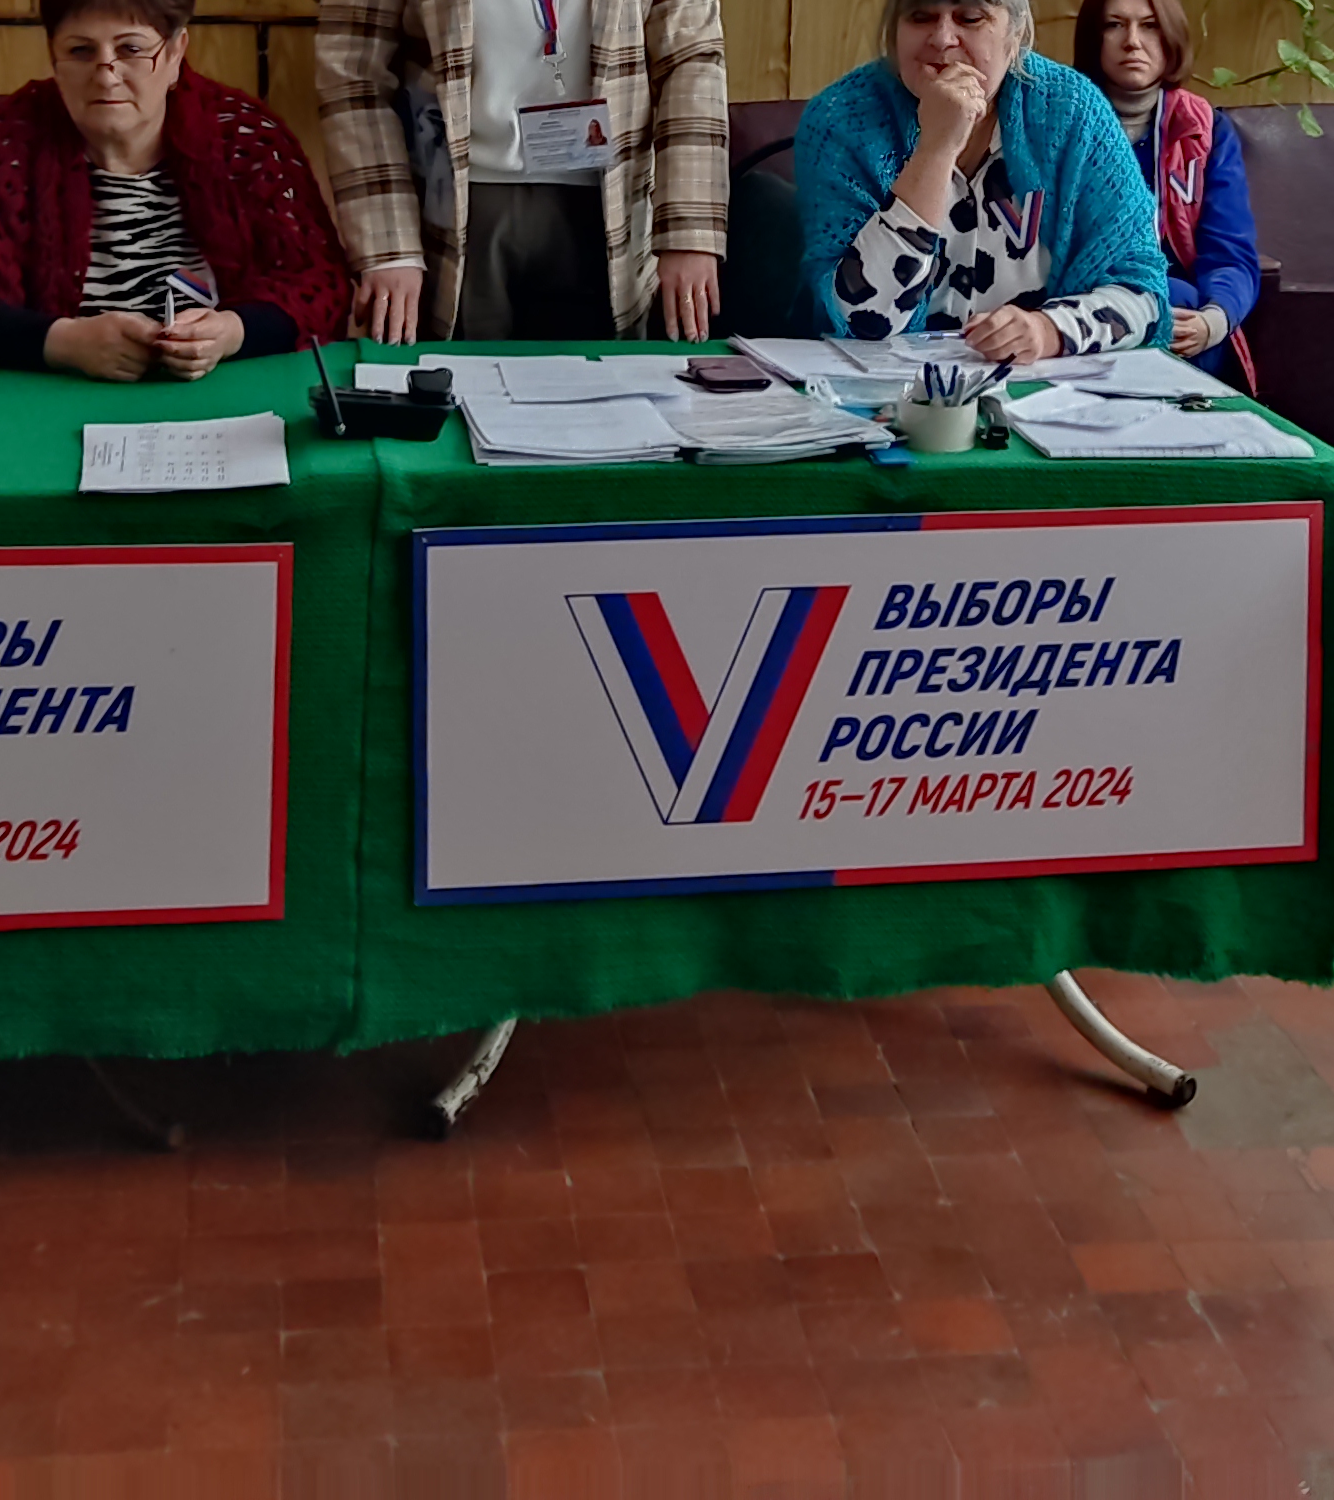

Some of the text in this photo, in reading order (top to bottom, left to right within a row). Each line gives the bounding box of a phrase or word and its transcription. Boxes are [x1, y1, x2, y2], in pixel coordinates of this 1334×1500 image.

[873, 577, 1116, 630] ВЫБОРЫ
[846, 638, 1182, 698] ПРЕЗИДЕНТА
[818, 708, 1039, 762] РОССИИ
[907, 771, 1037, 815] МАРТА
[1041, 766, 1133, 810] 2024
